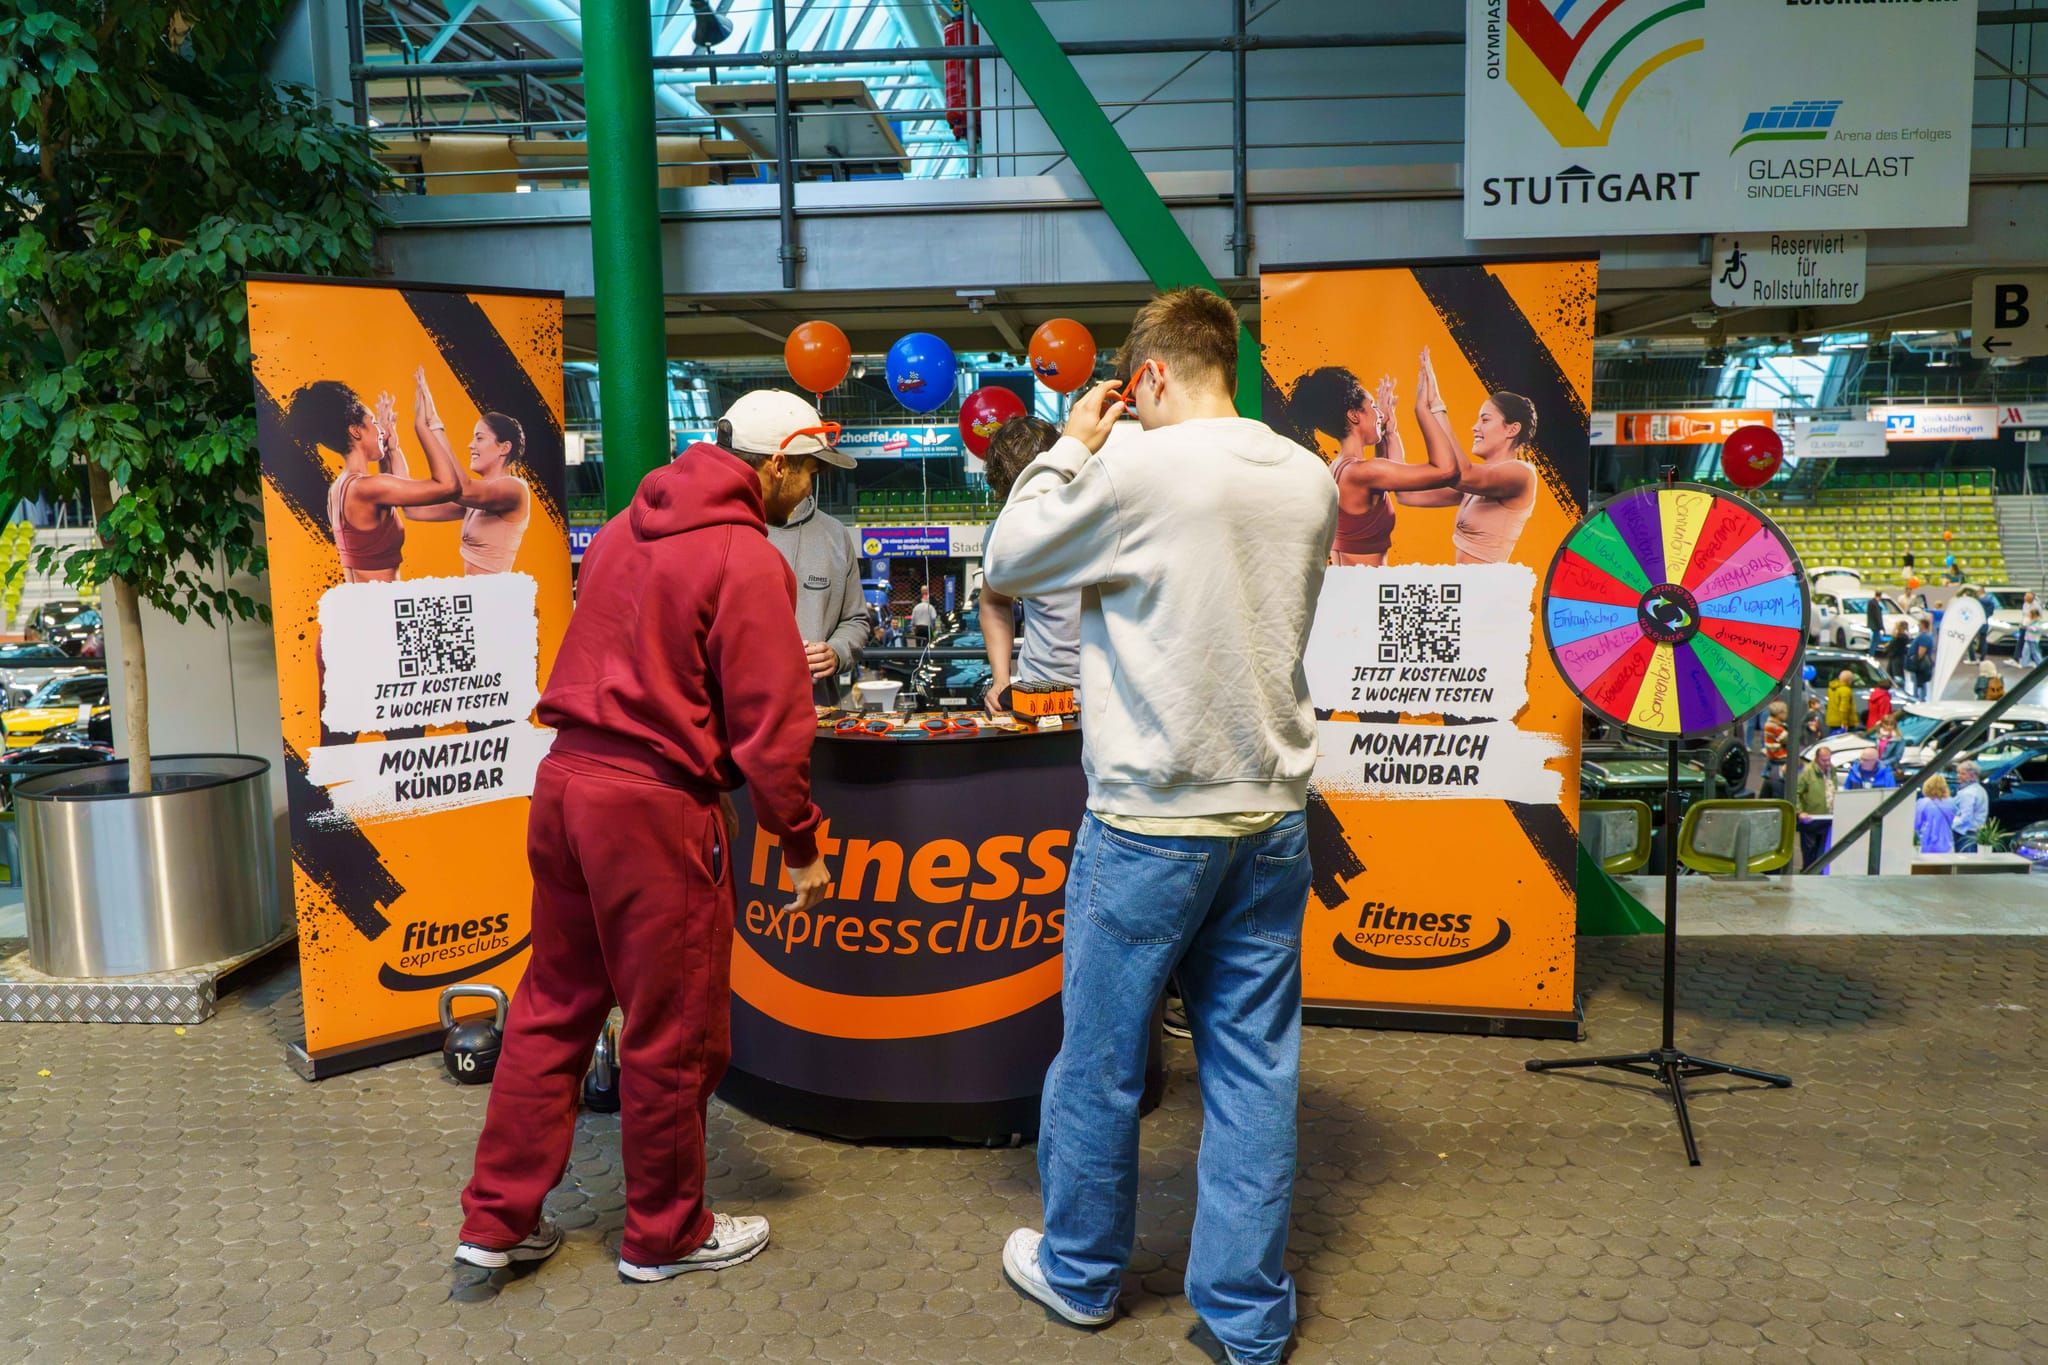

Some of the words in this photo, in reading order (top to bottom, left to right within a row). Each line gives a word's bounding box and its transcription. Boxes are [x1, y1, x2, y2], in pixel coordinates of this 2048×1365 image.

[1833, 129, 1872, 142] Arena
[1875, 128, 1898, 141] des
[1900, 127, 1952, 142] Erfolges
[1748, 156, 1915, 181] GLASPALAST
[1482, 164, 1701, 207] STUTTGART
[1746, 183, 1859, 199] SINDELFINGEN
[1770, 233, 1845, 256] Reserviert
[1796, 256, 1818, 277] für
[1753, 278, 1860, 301] Rollstuhlfahrer
[1994, 283, 2030, 329] B
[839, 430, 909, 443] choeffel.de
[1921, 424, 1984, 434] Sindelfingen
[374, 681, 417, 700] JETZT
[421, 672, 502, 695] KOSTENLOS
[1351, 667, 1395, 682] JETZT
[1399, 666, 1487, 683] KOSTENLOS
[375, 705, 385, 719] 2
[390, 697, 452, 717] WOCHEN
[456, 691, 509, 710] TESTEN
[1351, 687, 1360, 701] 2
[1365, 687, 1432, 704] WOCHEN
[1435, 687, 1494, 703] TESTEN
[378, 736, 511, 776] MONATLICH
[1349, 732, 1490, 761] MONATLICH
[1363, 756, 1480, 786] KÜNDBAR
[394, 766, 505, 802] KÜNDBAR
[1357, 901, 1473, 933] fitness
[402, 912, 510, 952] fitness
[454, 1052, 476, 1073] 16
